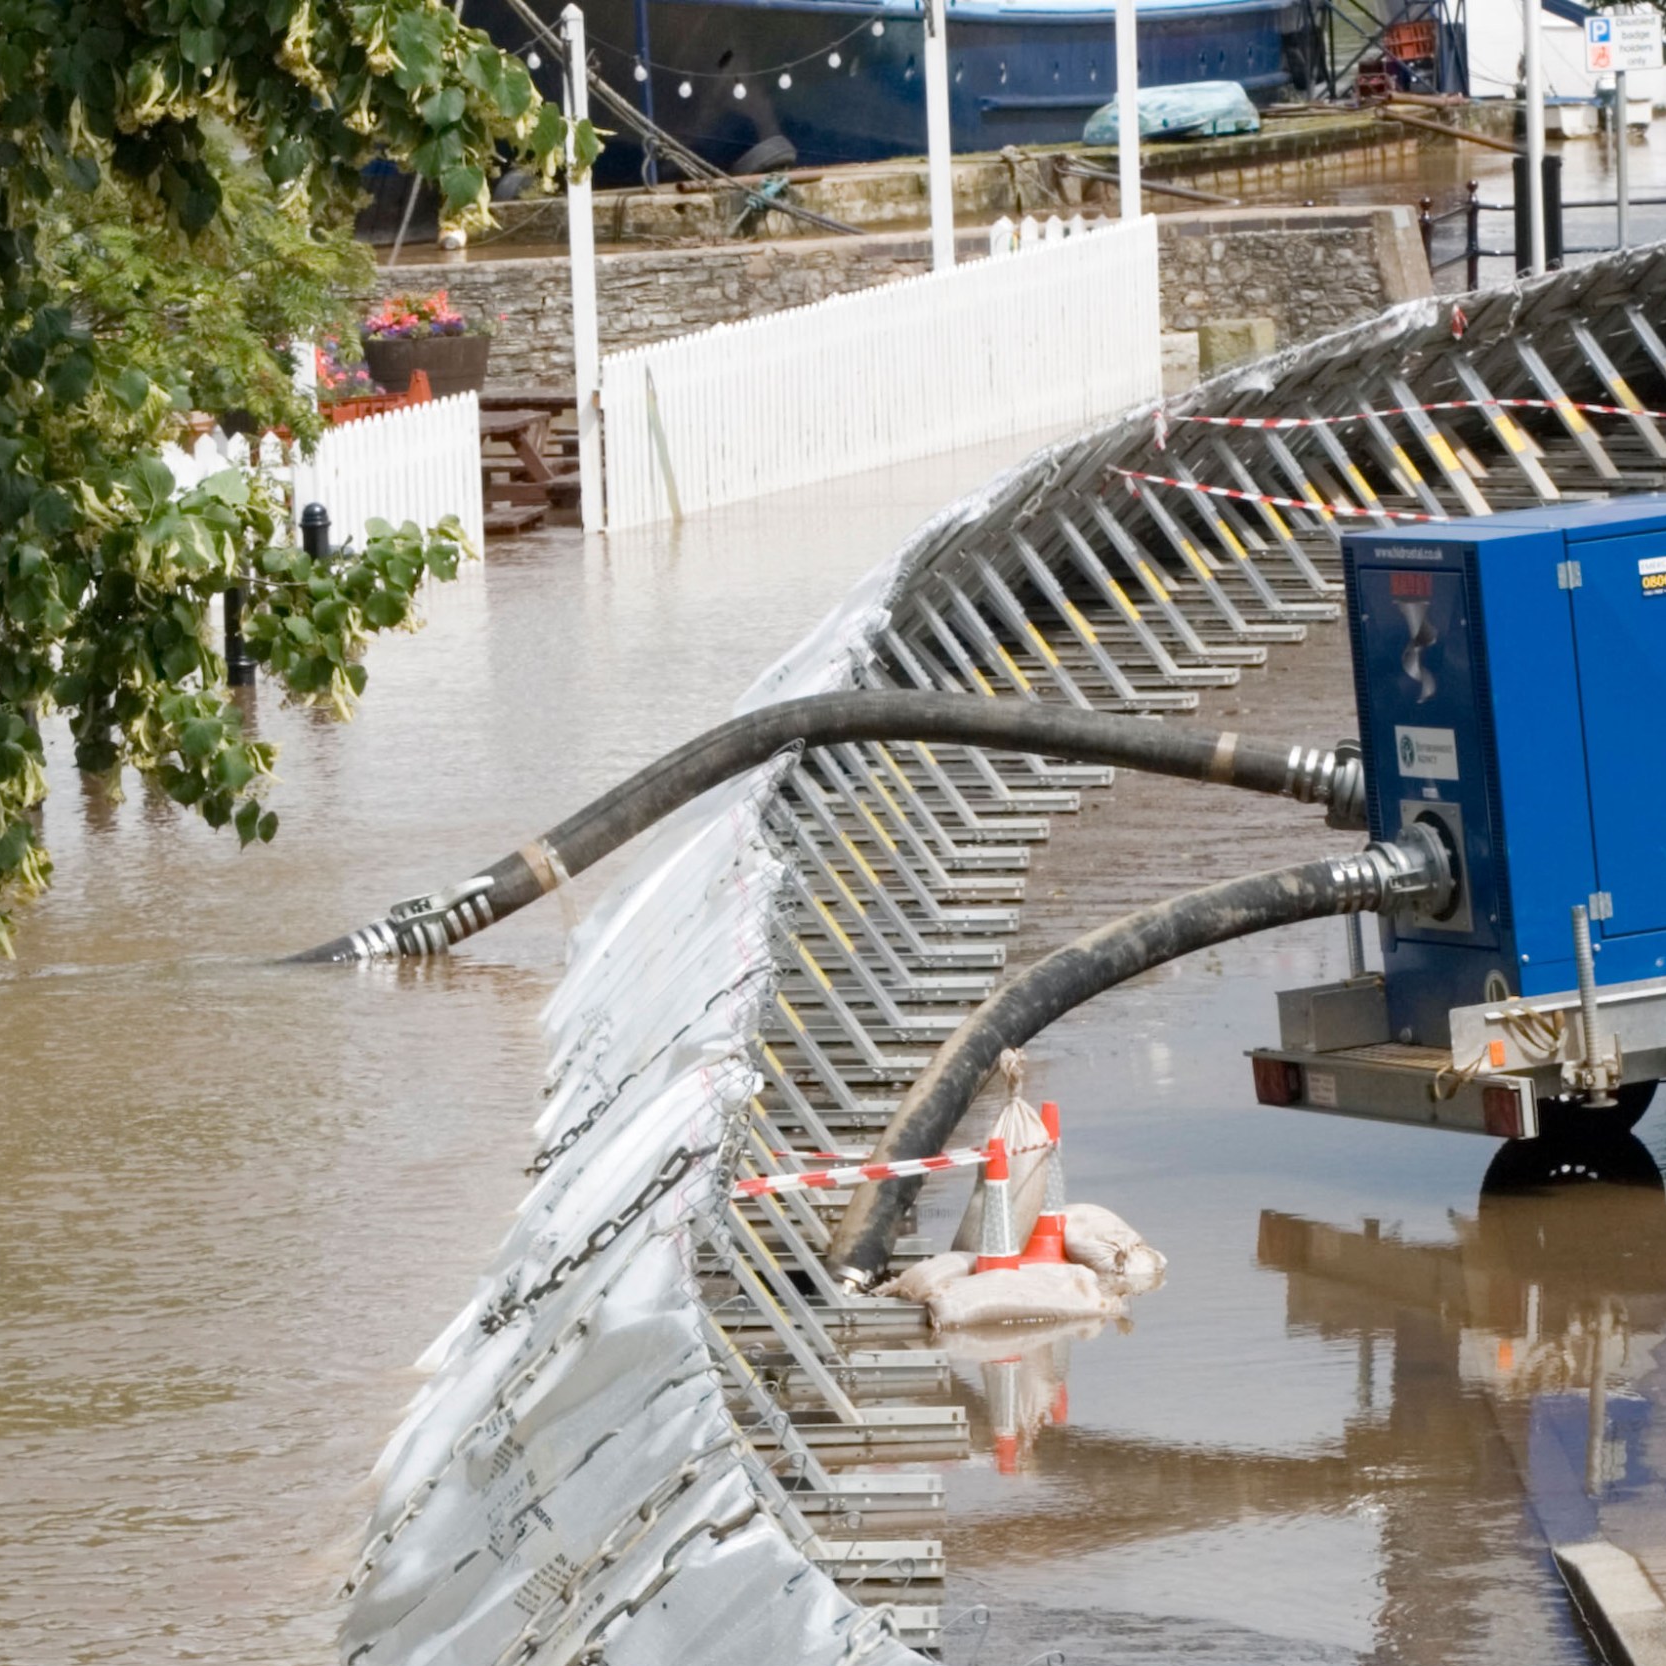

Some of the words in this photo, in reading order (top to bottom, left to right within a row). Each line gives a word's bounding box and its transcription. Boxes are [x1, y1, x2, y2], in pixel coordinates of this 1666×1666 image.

[1615, 17, 1655, 26] Disabled
[1621, 31, 1650, 40] badge
[1619, 45, 1653, 53] holders
